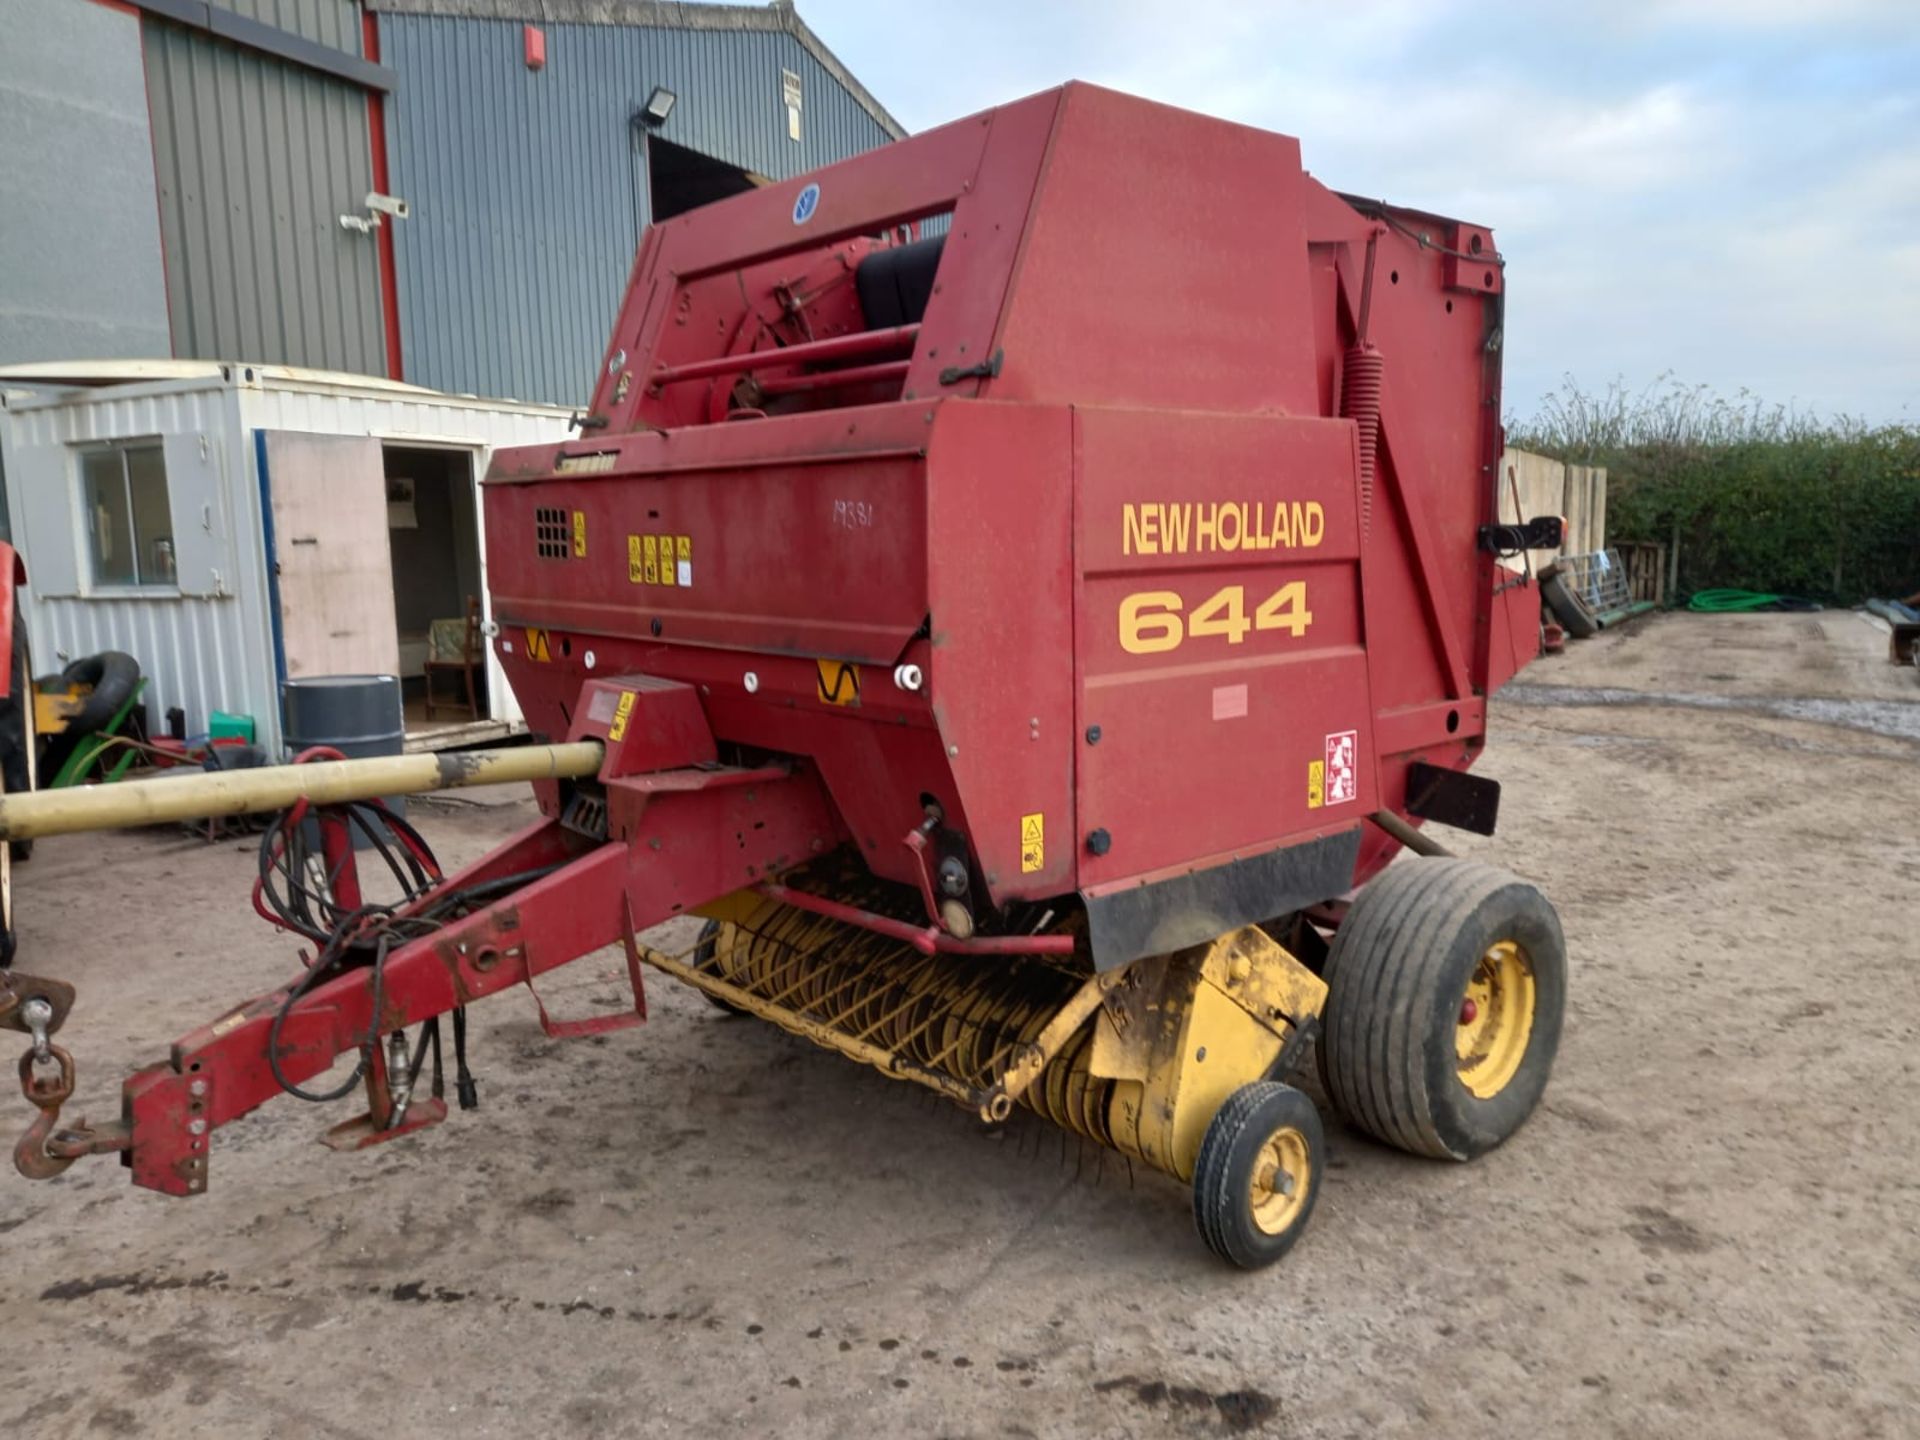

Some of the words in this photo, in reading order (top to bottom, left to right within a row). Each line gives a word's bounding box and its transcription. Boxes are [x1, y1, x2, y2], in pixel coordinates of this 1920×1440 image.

[1123, 503, 1191, 555] NEW
[1196, 501, 1325, 552] HOLLAND
[1118, 581, 1313, 654] 644
